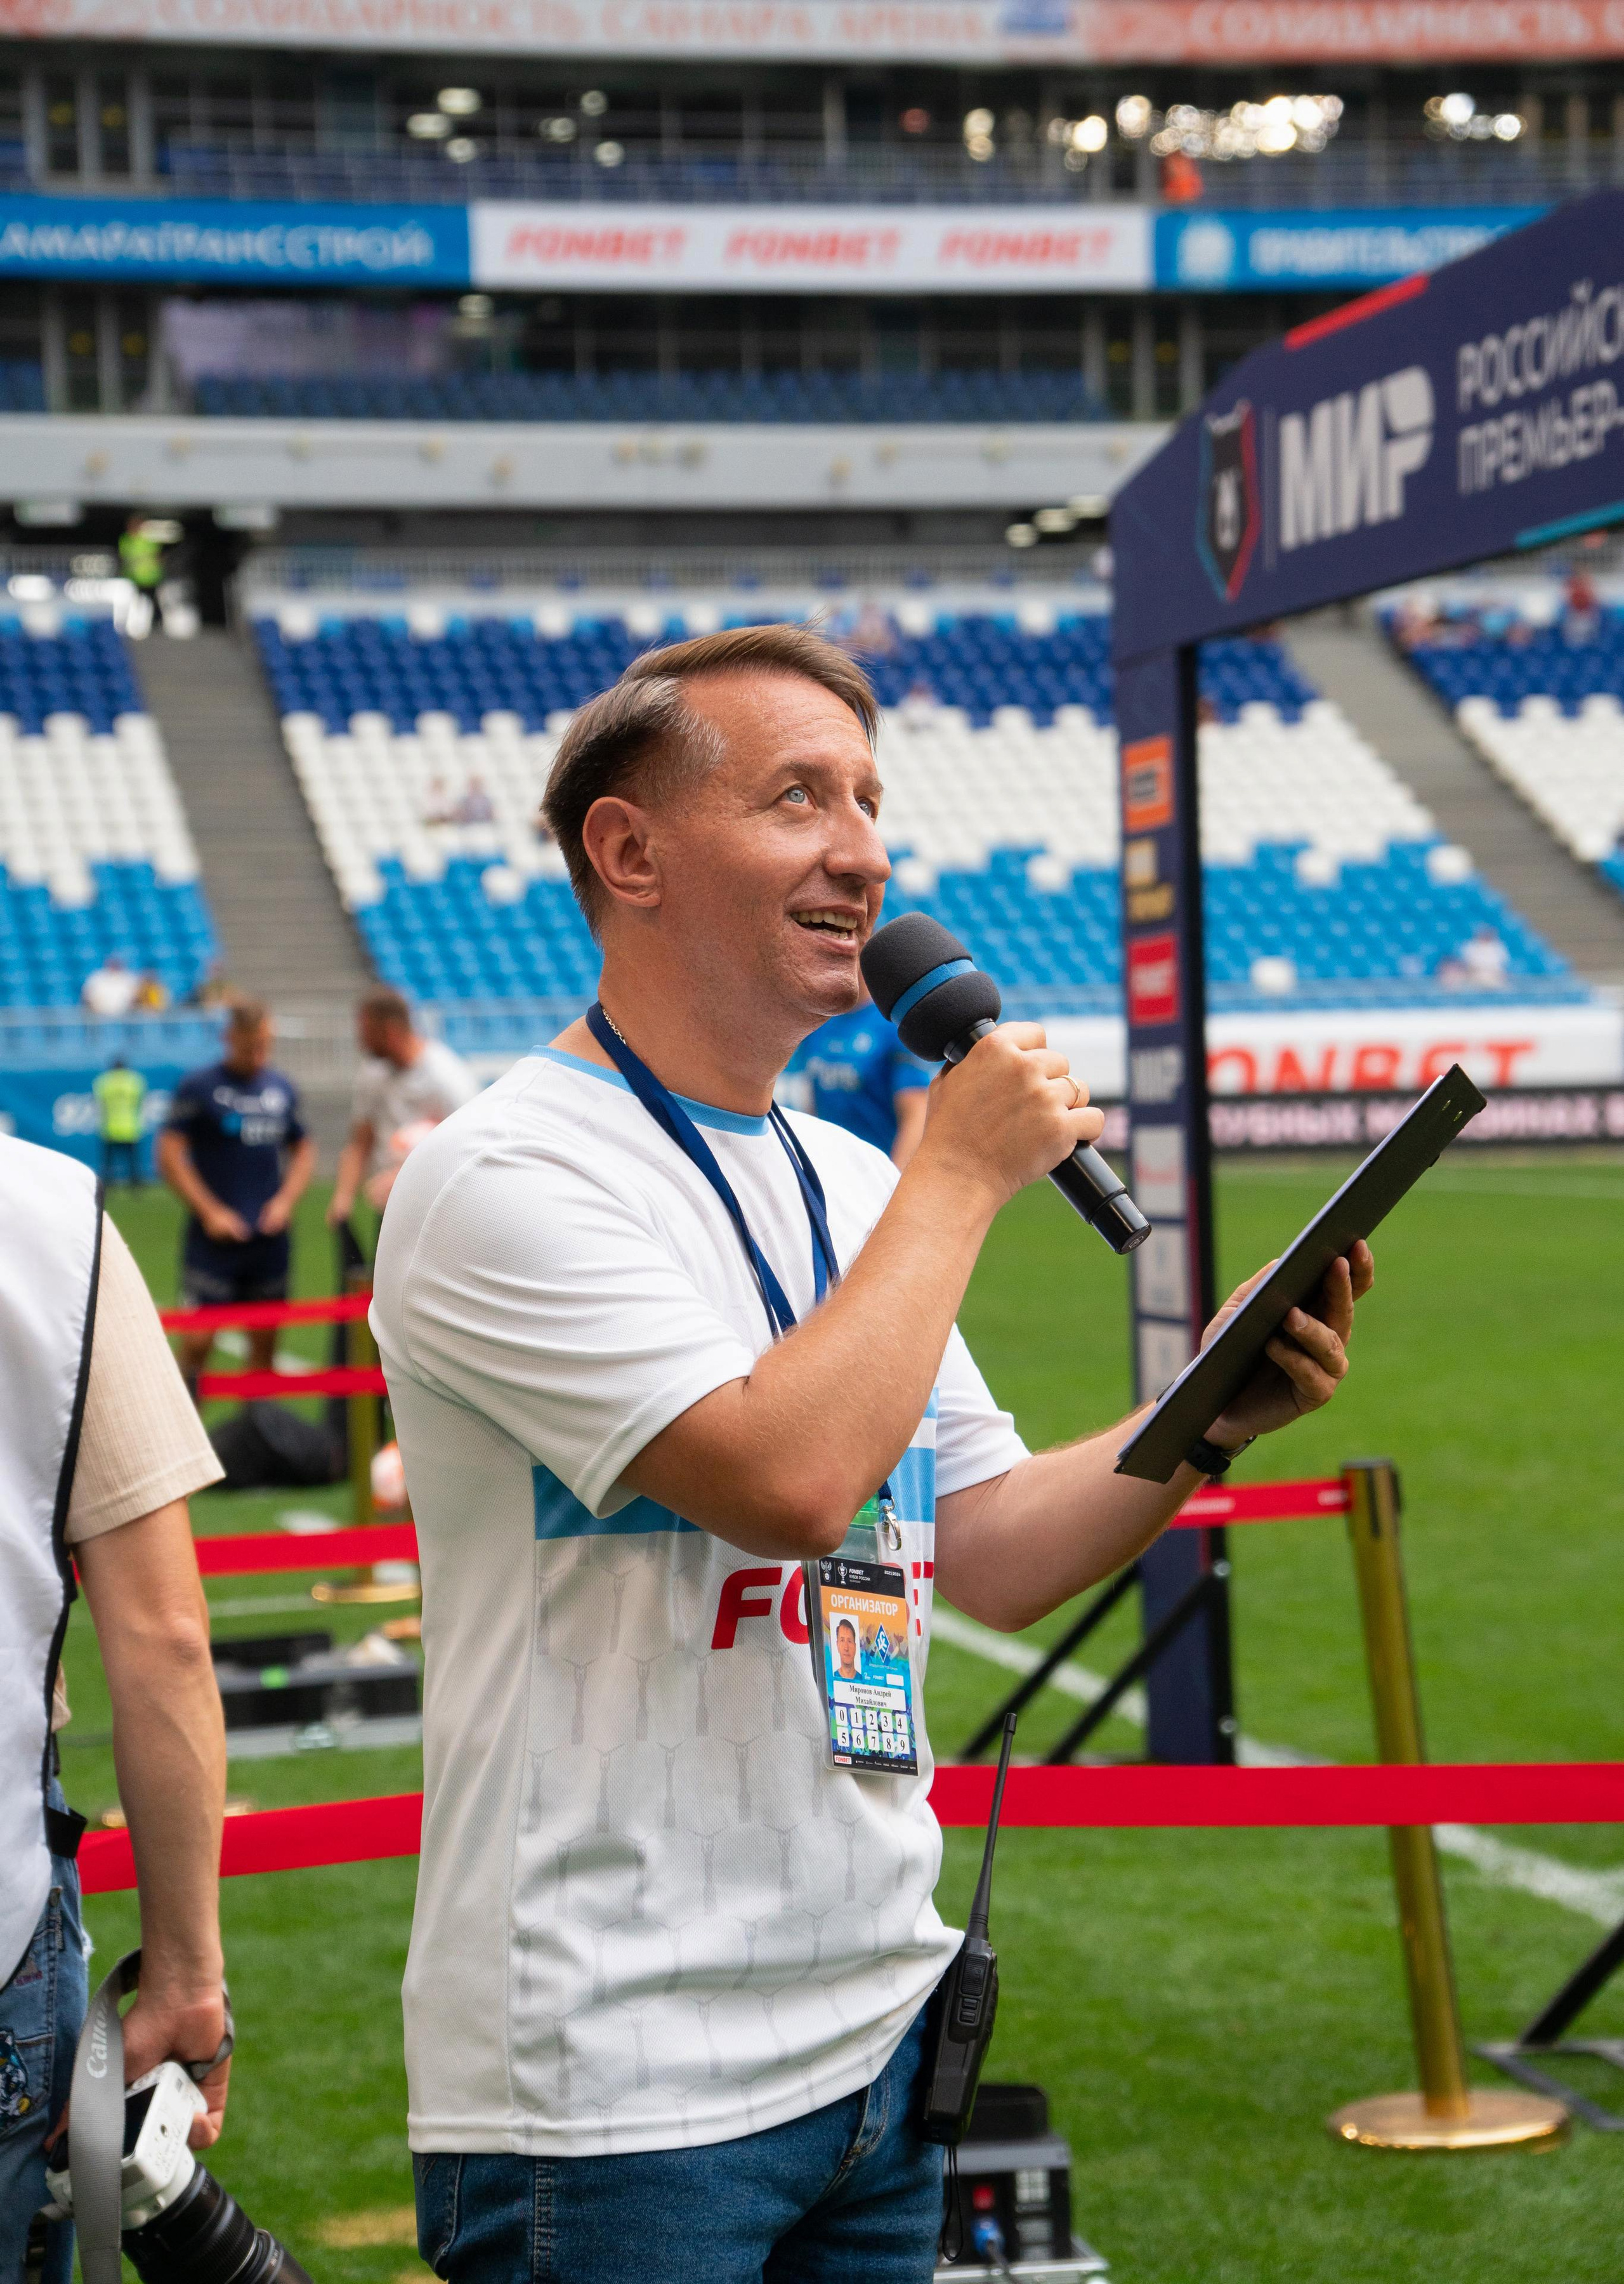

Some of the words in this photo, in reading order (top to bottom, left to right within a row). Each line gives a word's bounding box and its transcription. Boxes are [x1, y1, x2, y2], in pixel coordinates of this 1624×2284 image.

[509, 226, 686, 266] FONBET
[728, 226, 901, 268] FONBET
[940, 226, 1114, 269] FONBET
[1457, 279, 1624, 414] РОССИЙС
[1280, 365, 1435, 551] МИР
[1207, 1039, 1538, 1090] ONBET
[830, 1594, 898, 1617] ОРГАНИЗАТОР
[849, 1684, 872, 1695] Миронов
[873, 1689, 892, 1698] Андрей
[855, 1696, 887, 1707] Михайлович
[840, 1709, 844, 1721] 0
[855, 1712, 859, 1723] 1
[870, 1714, 874, 1725] 2
[884, 1716, 888, 1727] 3
[898, 1717, 902, 1729] 4
[842, 1732, 847, 1744] 5
[856, 1734, 861, 1745] 6
[871, 1736, 875, 1748] 7
[886, 1738, 891, 1750] 8
[900, 1740, 905, 1751] 9
[86, 2004, 108, 2078] Cano
